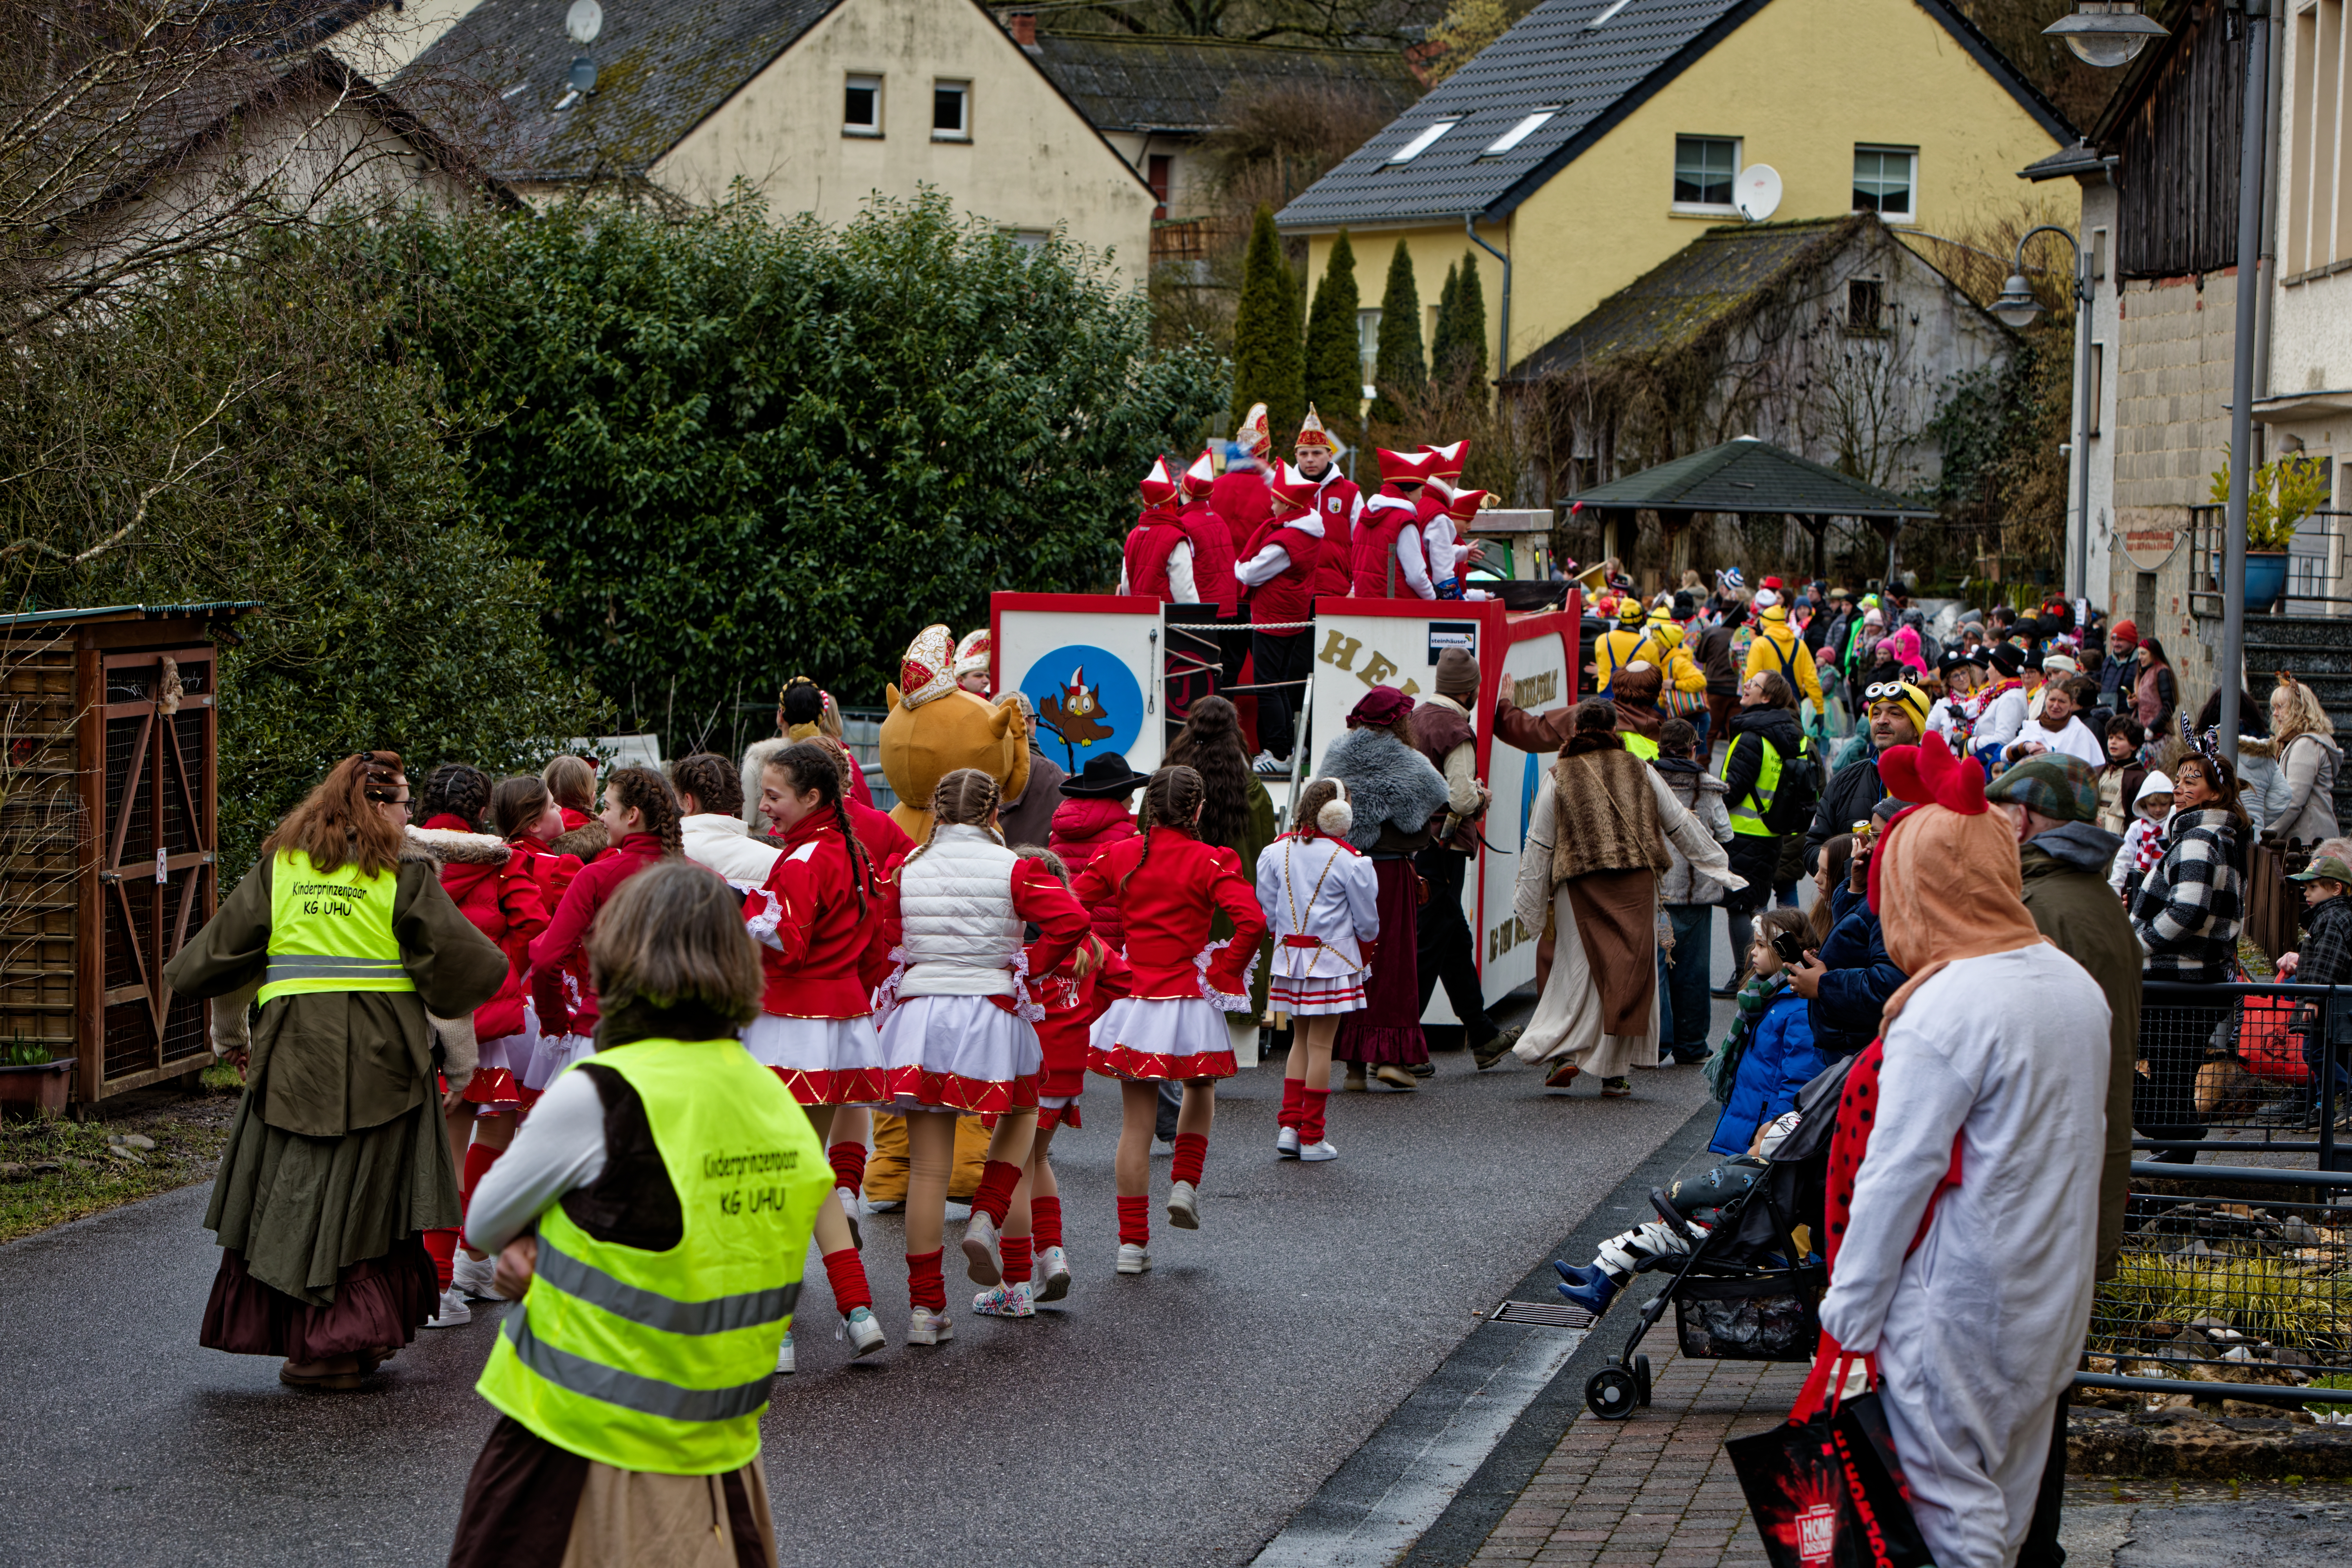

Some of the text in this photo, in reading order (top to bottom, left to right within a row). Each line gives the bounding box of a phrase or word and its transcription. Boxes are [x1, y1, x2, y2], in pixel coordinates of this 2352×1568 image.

[292, 880, 367, 901] Kinderprinzenpaar
[304, 901, 352, 916] KG UHU
[704, 1147, 799, 1183] Kinderprinzenpaar
[720, 1187, 786, 1217] KG UHU
[1801, 1516, 1833, 1541] HOME
